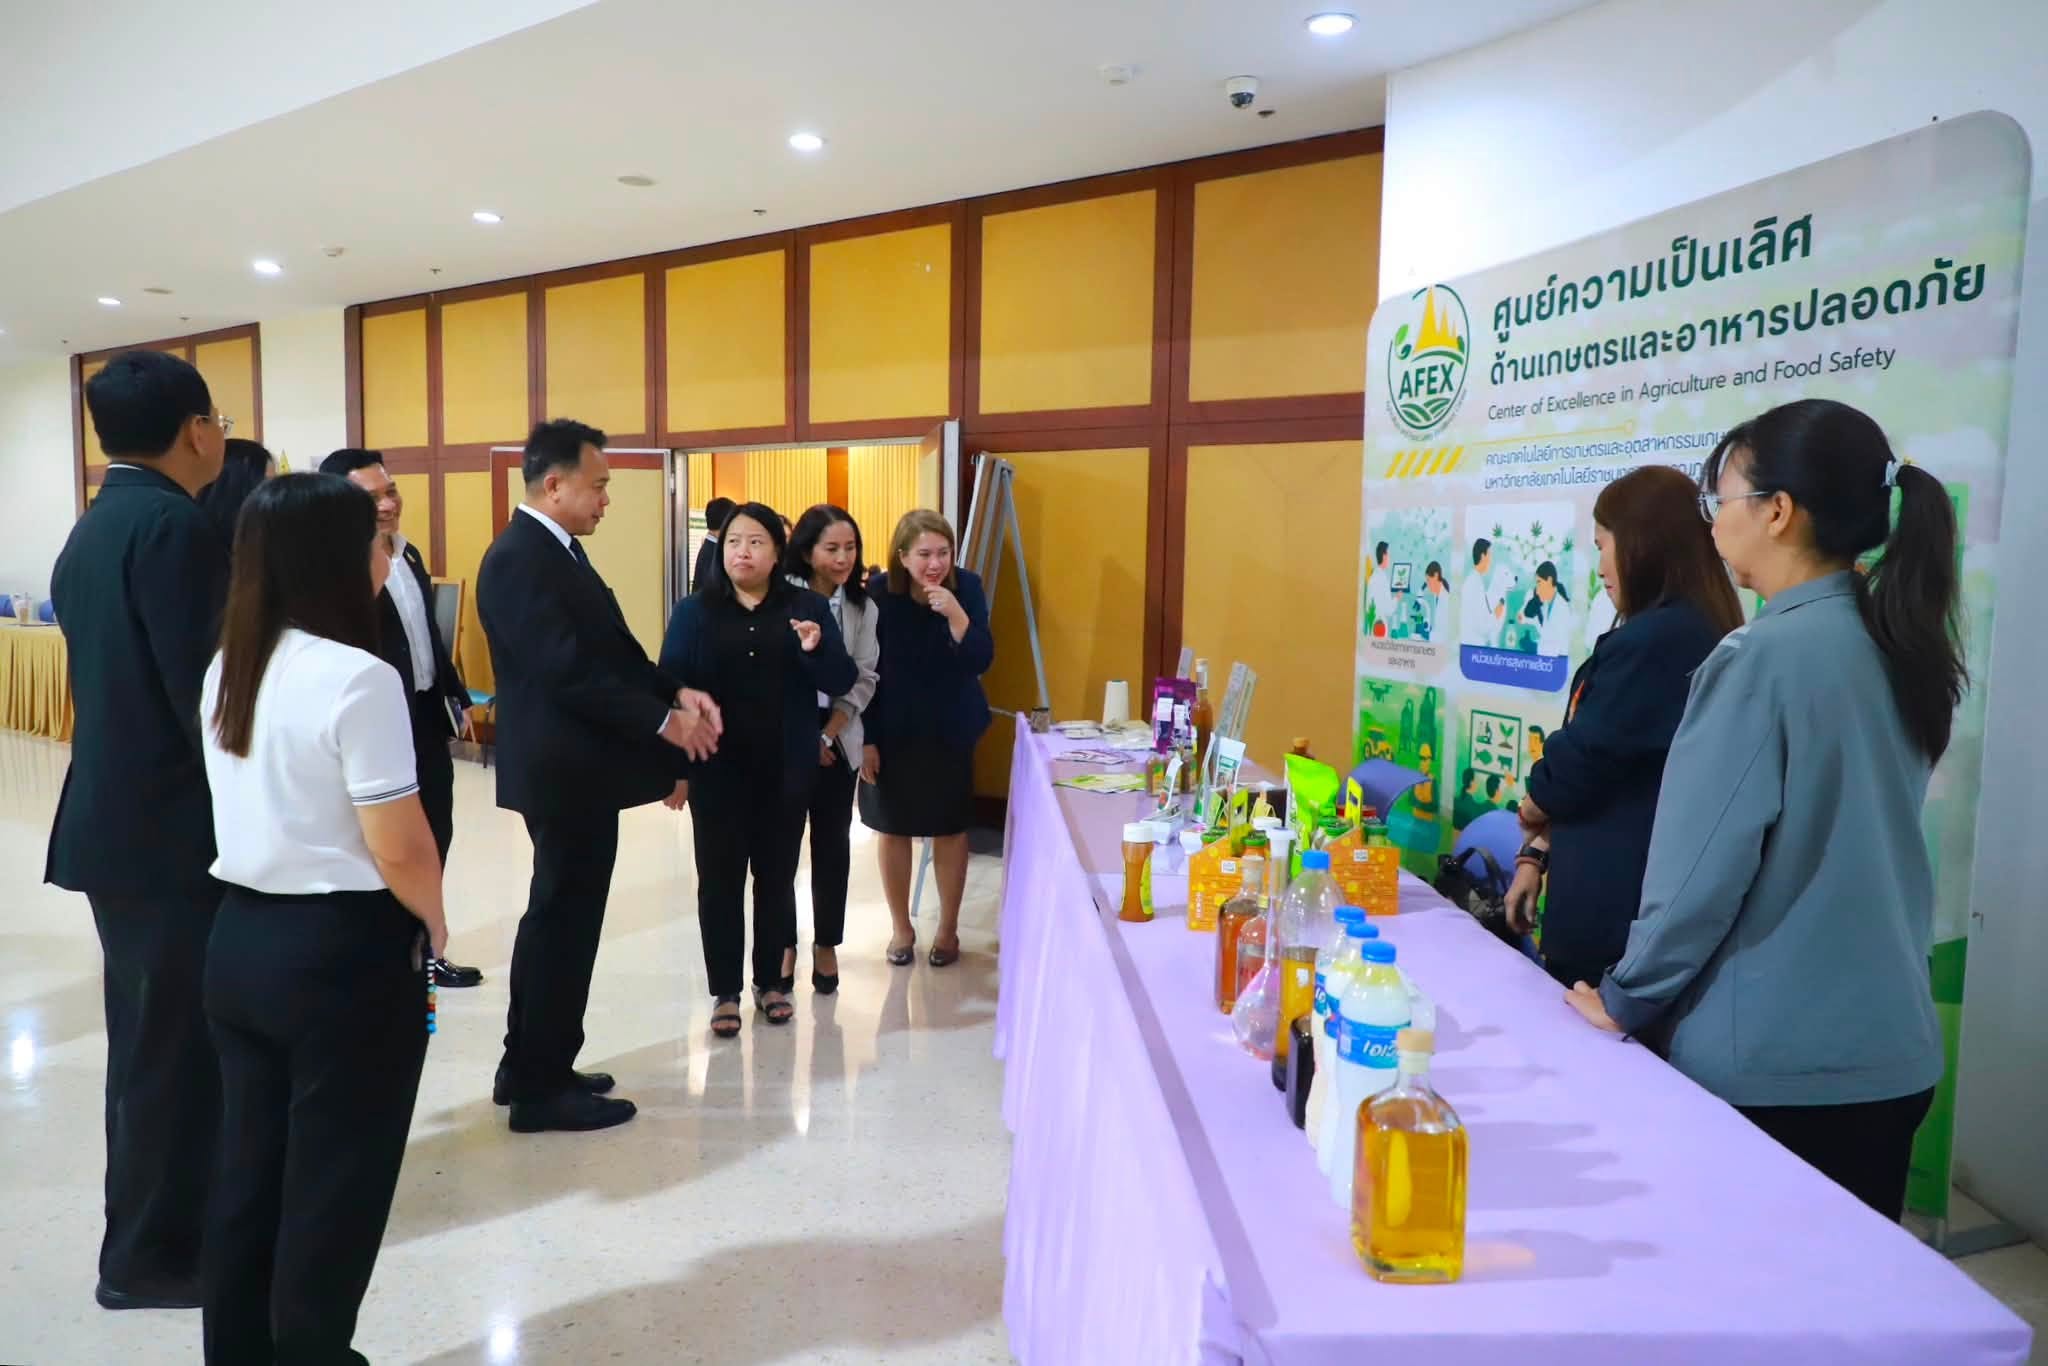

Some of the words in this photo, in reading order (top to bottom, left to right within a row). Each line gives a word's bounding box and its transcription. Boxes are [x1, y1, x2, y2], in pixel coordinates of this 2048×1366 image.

[1490, 257, 1986, 386] ด้านเกษตรและอาหารปลอดภัย
[1493, 213, 1813, 343] ศูนย์ความเป็นเลิศ
[1398, 361, 1455, 400] AFEX
[1488, 404, 1526, 420] Center
[1531, 397, 1543, 415] of
[1547, 391, 1616, 412] Excellence
[1621, 385, 1633, 402] in
[1638, 373, 1727, 402] Agriculture
[1733, 362, 1768, 386] and
[1774, 354, 1822, 380] Food
[1829, 347, 1896, 373] Safety
